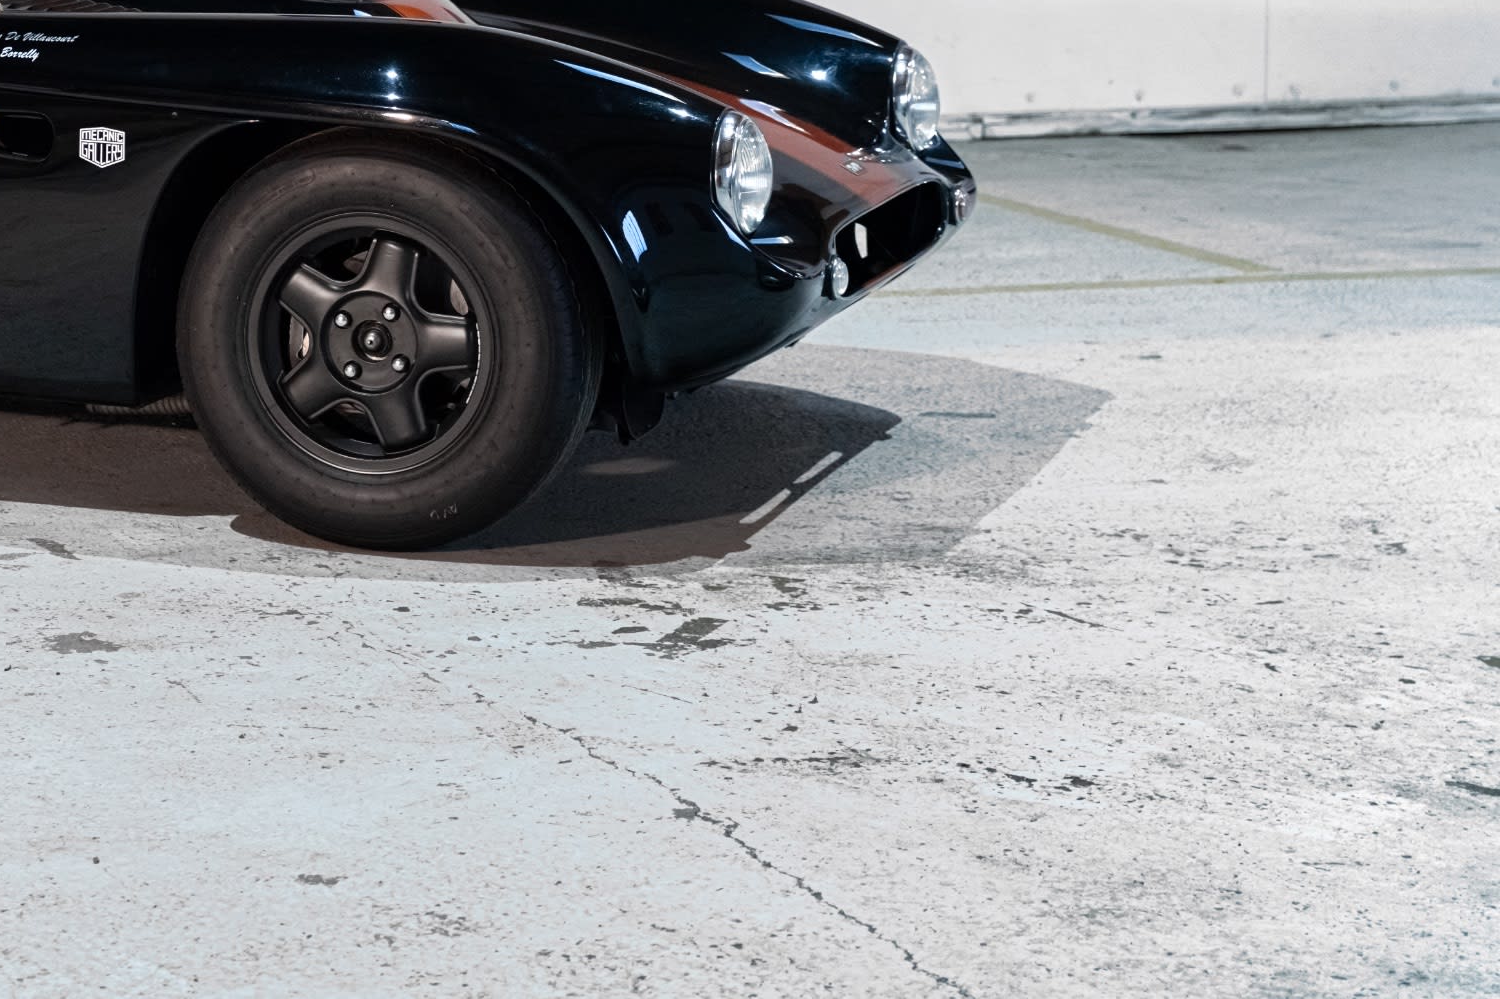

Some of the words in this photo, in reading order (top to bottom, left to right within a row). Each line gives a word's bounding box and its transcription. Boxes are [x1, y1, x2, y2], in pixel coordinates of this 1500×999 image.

[4, 31, 21, 41] De
[0, 46, 41, 62] Borrelly
[81, 129, 123, 142] MECANIC
[81, 142, 123, 166] GALLERY
